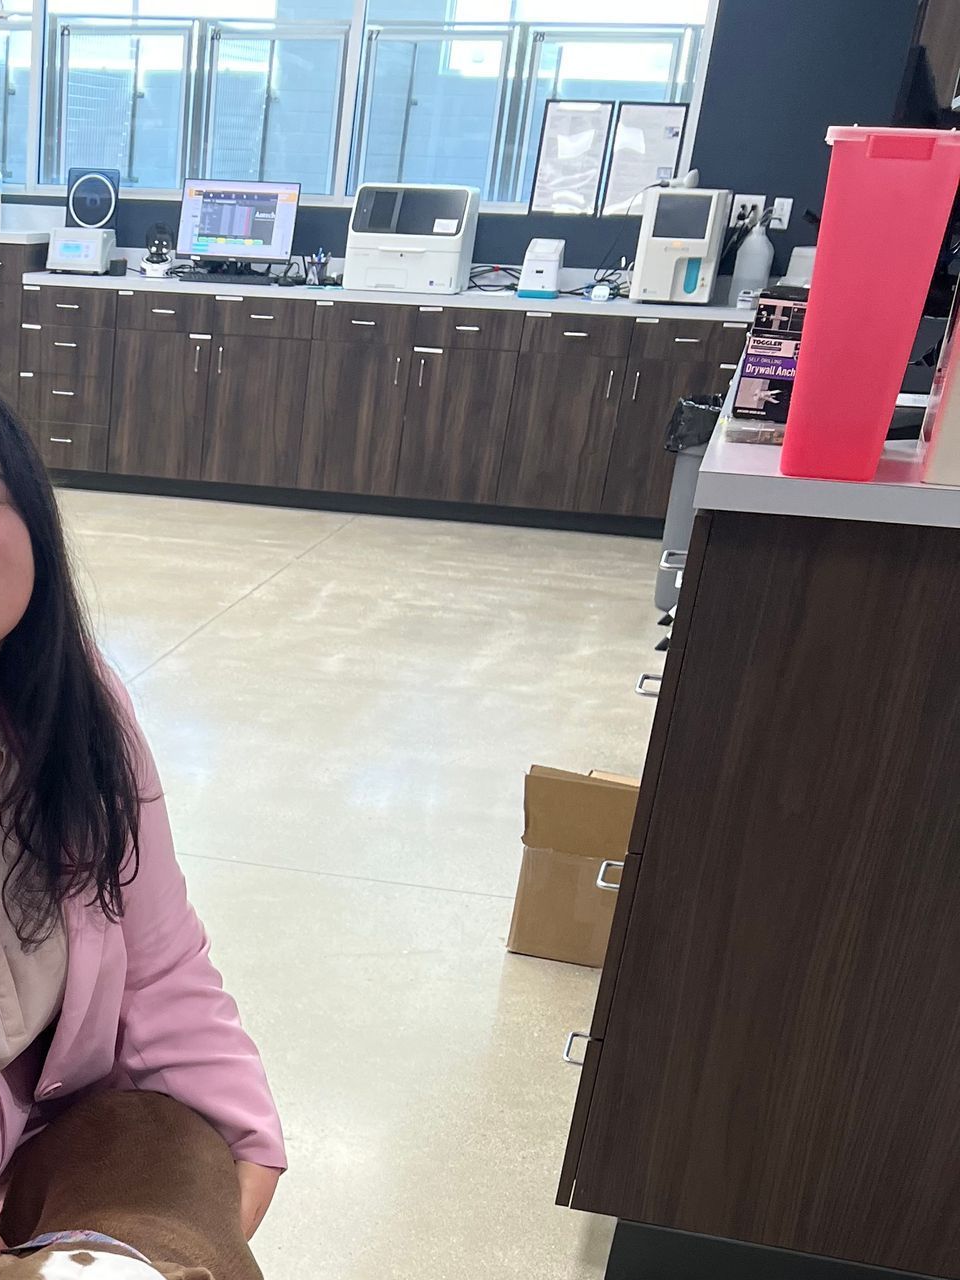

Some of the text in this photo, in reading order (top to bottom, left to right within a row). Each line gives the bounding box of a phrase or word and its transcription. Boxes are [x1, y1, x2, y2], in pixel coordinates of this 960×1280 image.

[61, 25, 70, 36] 25
[211, 29, 221, 41] 26
[367, 29, 381, 41] 27
[533, 31, 545, 43] 28
[745, 363, 775, 376] Drywall
